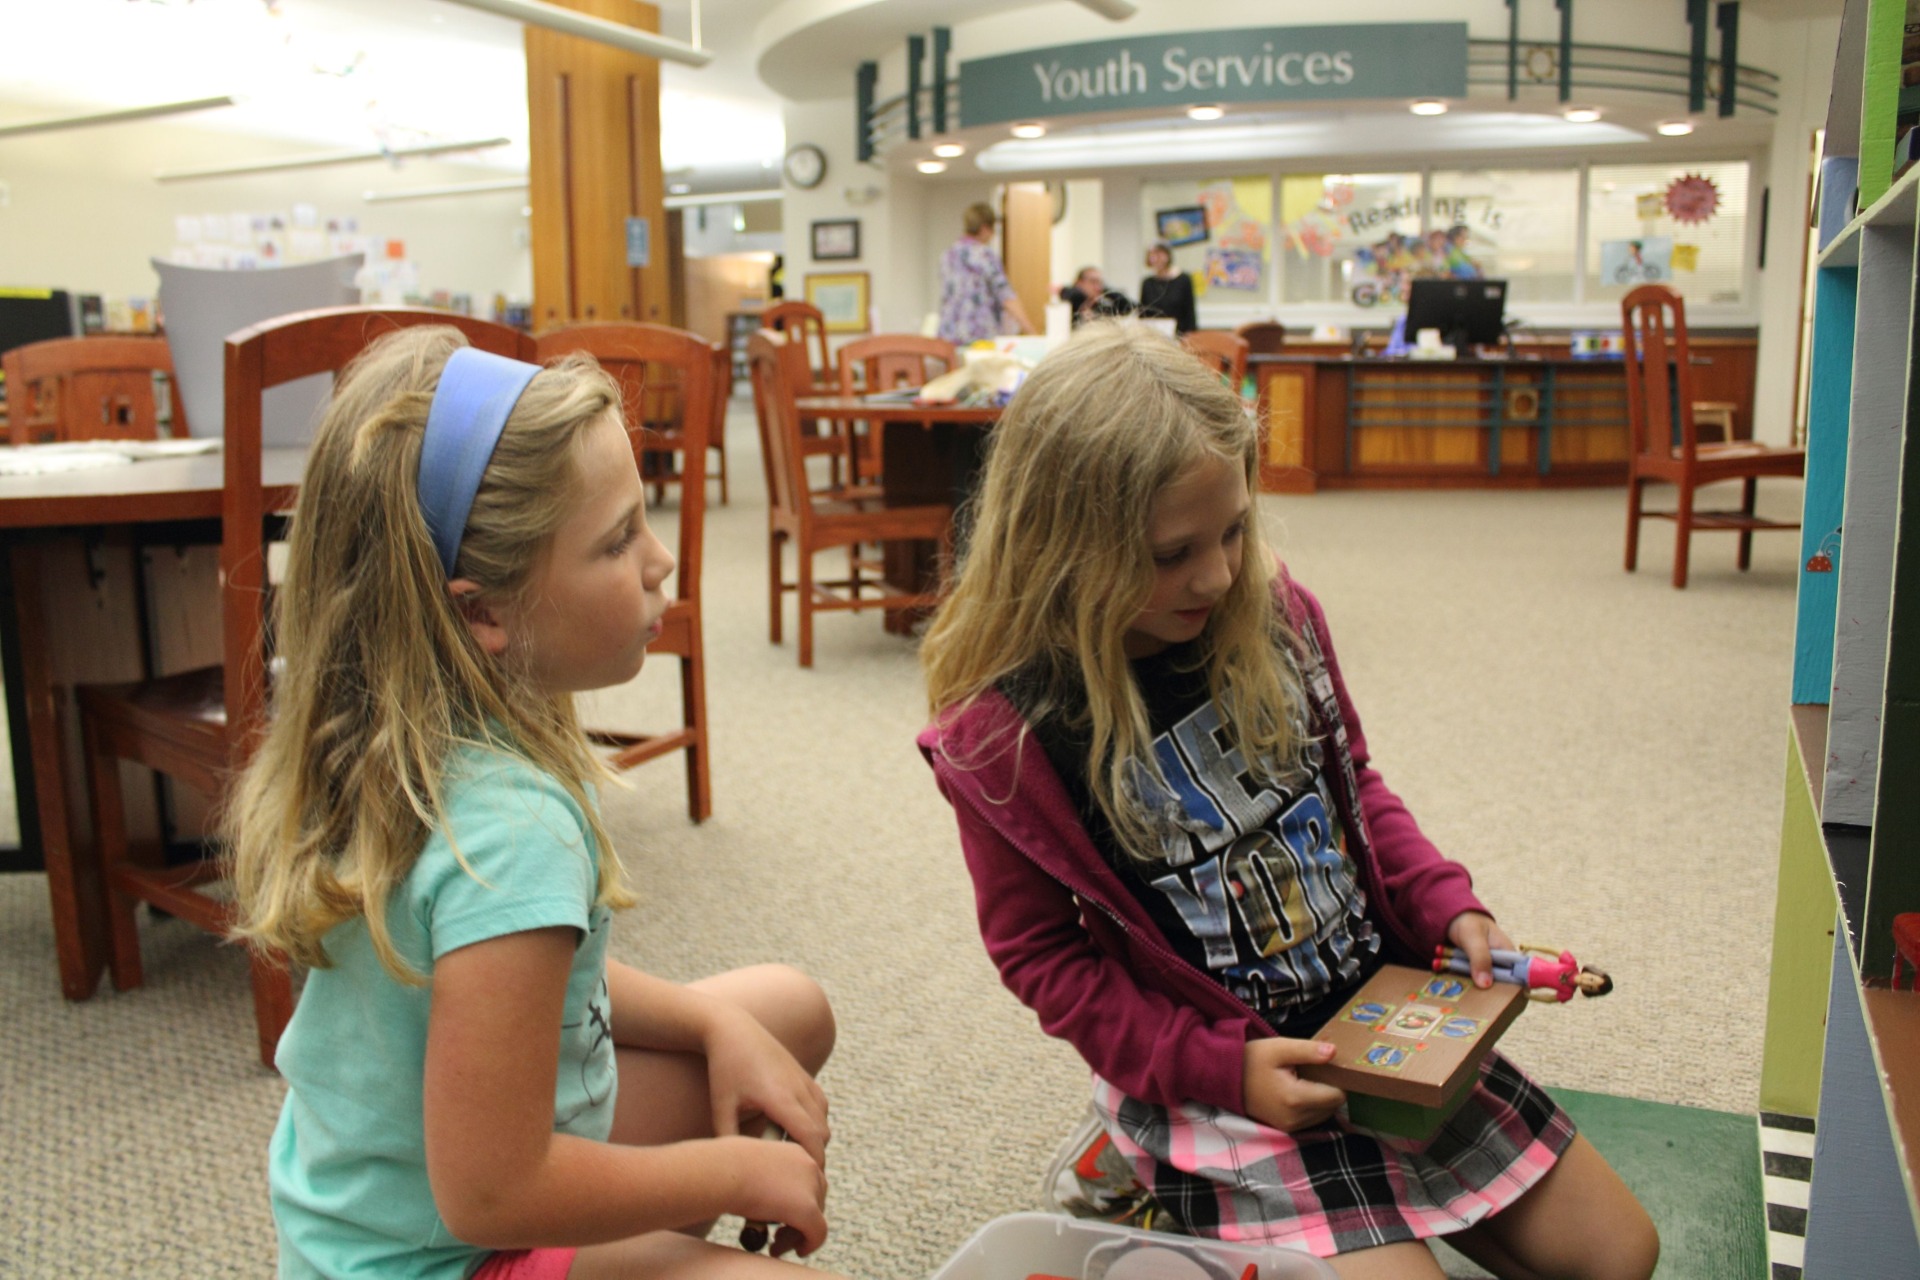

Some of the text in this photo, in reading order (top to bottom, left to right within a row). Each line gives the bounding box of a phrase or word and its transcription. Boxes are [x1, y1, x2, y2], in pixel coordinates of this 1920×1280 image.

[1033, 42, 1355, 102] Youth Services
[1348, 192, 1468, 235] Reading
